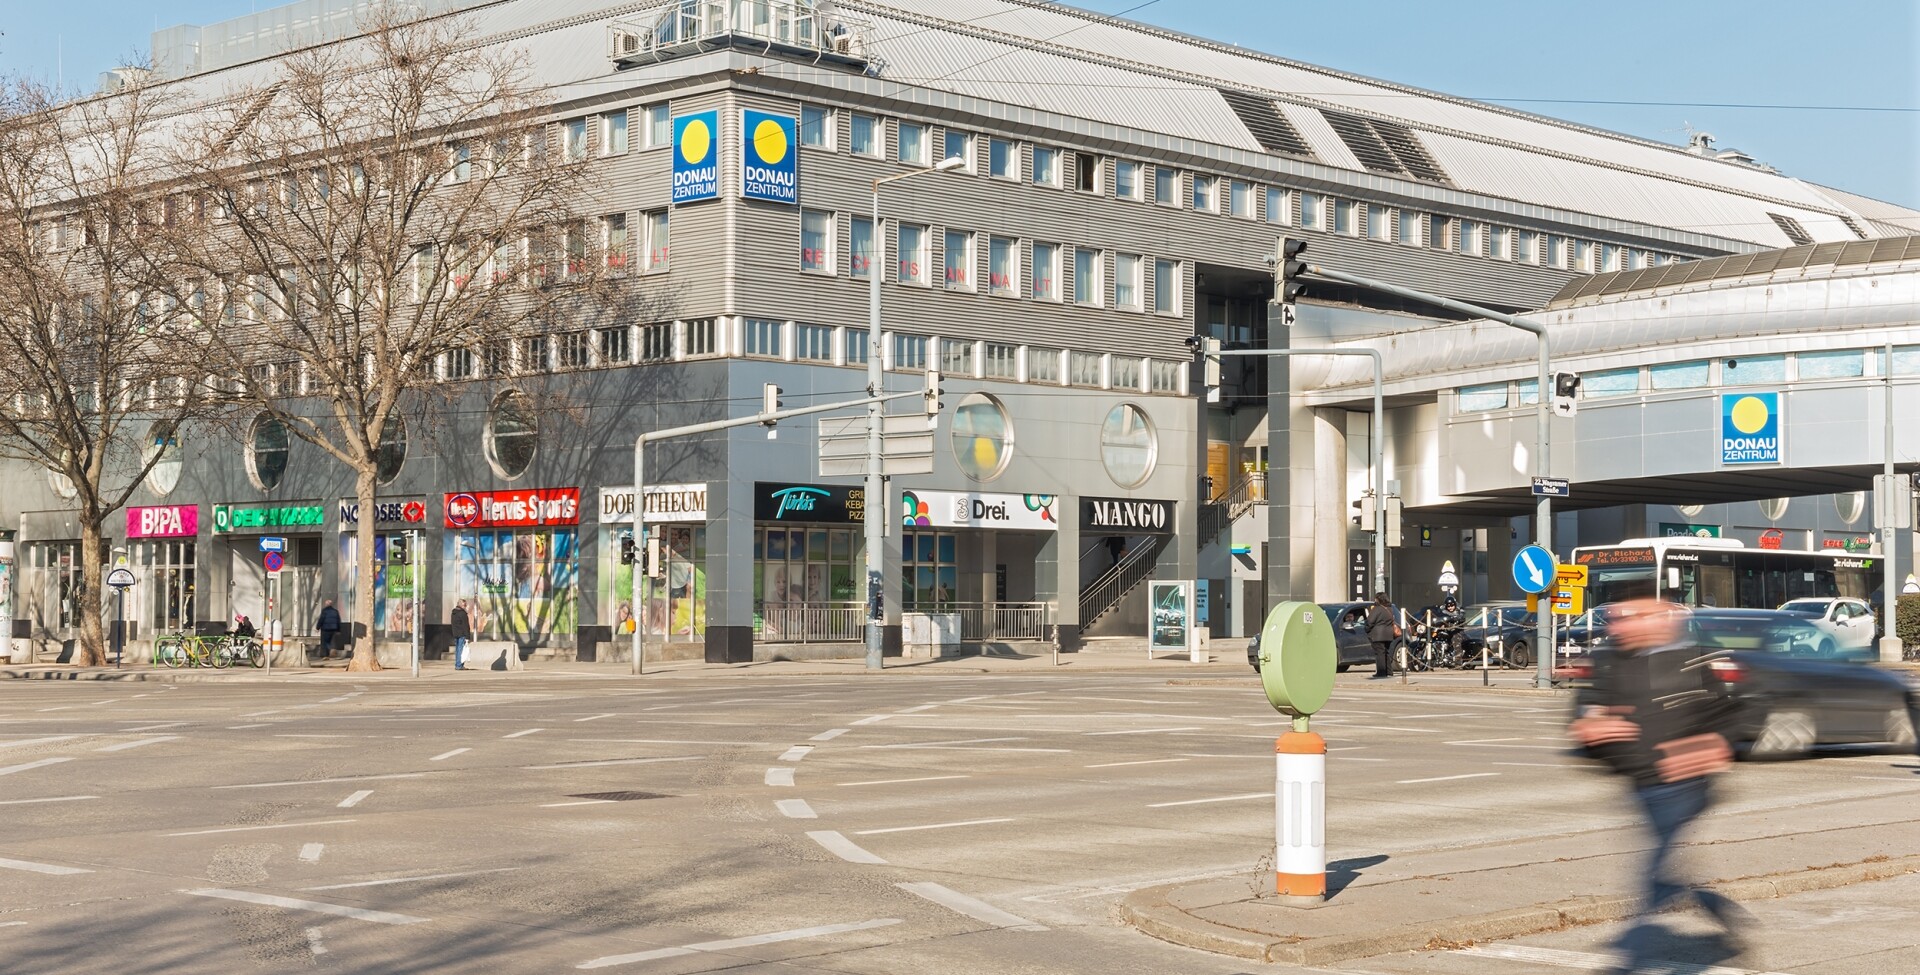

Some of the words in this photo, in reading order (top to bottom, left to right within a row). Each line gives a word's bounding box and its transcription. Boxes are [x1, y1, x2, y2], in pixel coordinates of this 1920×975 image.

[674, 167, 716, 187] DONAU
[746, 166, 794, 186] DONAU
[673, 182, 716, 199] ZENTRUM
[746, 181, 794, 199] ZENTRUM
[1724, 437, 1777, 451] DONAU
[1724, 449, 1777, 460] ZENTRUM
[481, 496, 527, 521] Hervis
[528, 494, 577, 525] Sports
[845, 500, 865, 510] KEBA
[972, 499, 1010, 521] Drei.
[141, 507, 183, 535] BIPA
[848, 511, 865, 521] PIZZ
[1091, 500, 1166, 529] MANGO
[1598, 551, 1612, 559] Dr.
[1614, 549, 1651, 558] Richard
